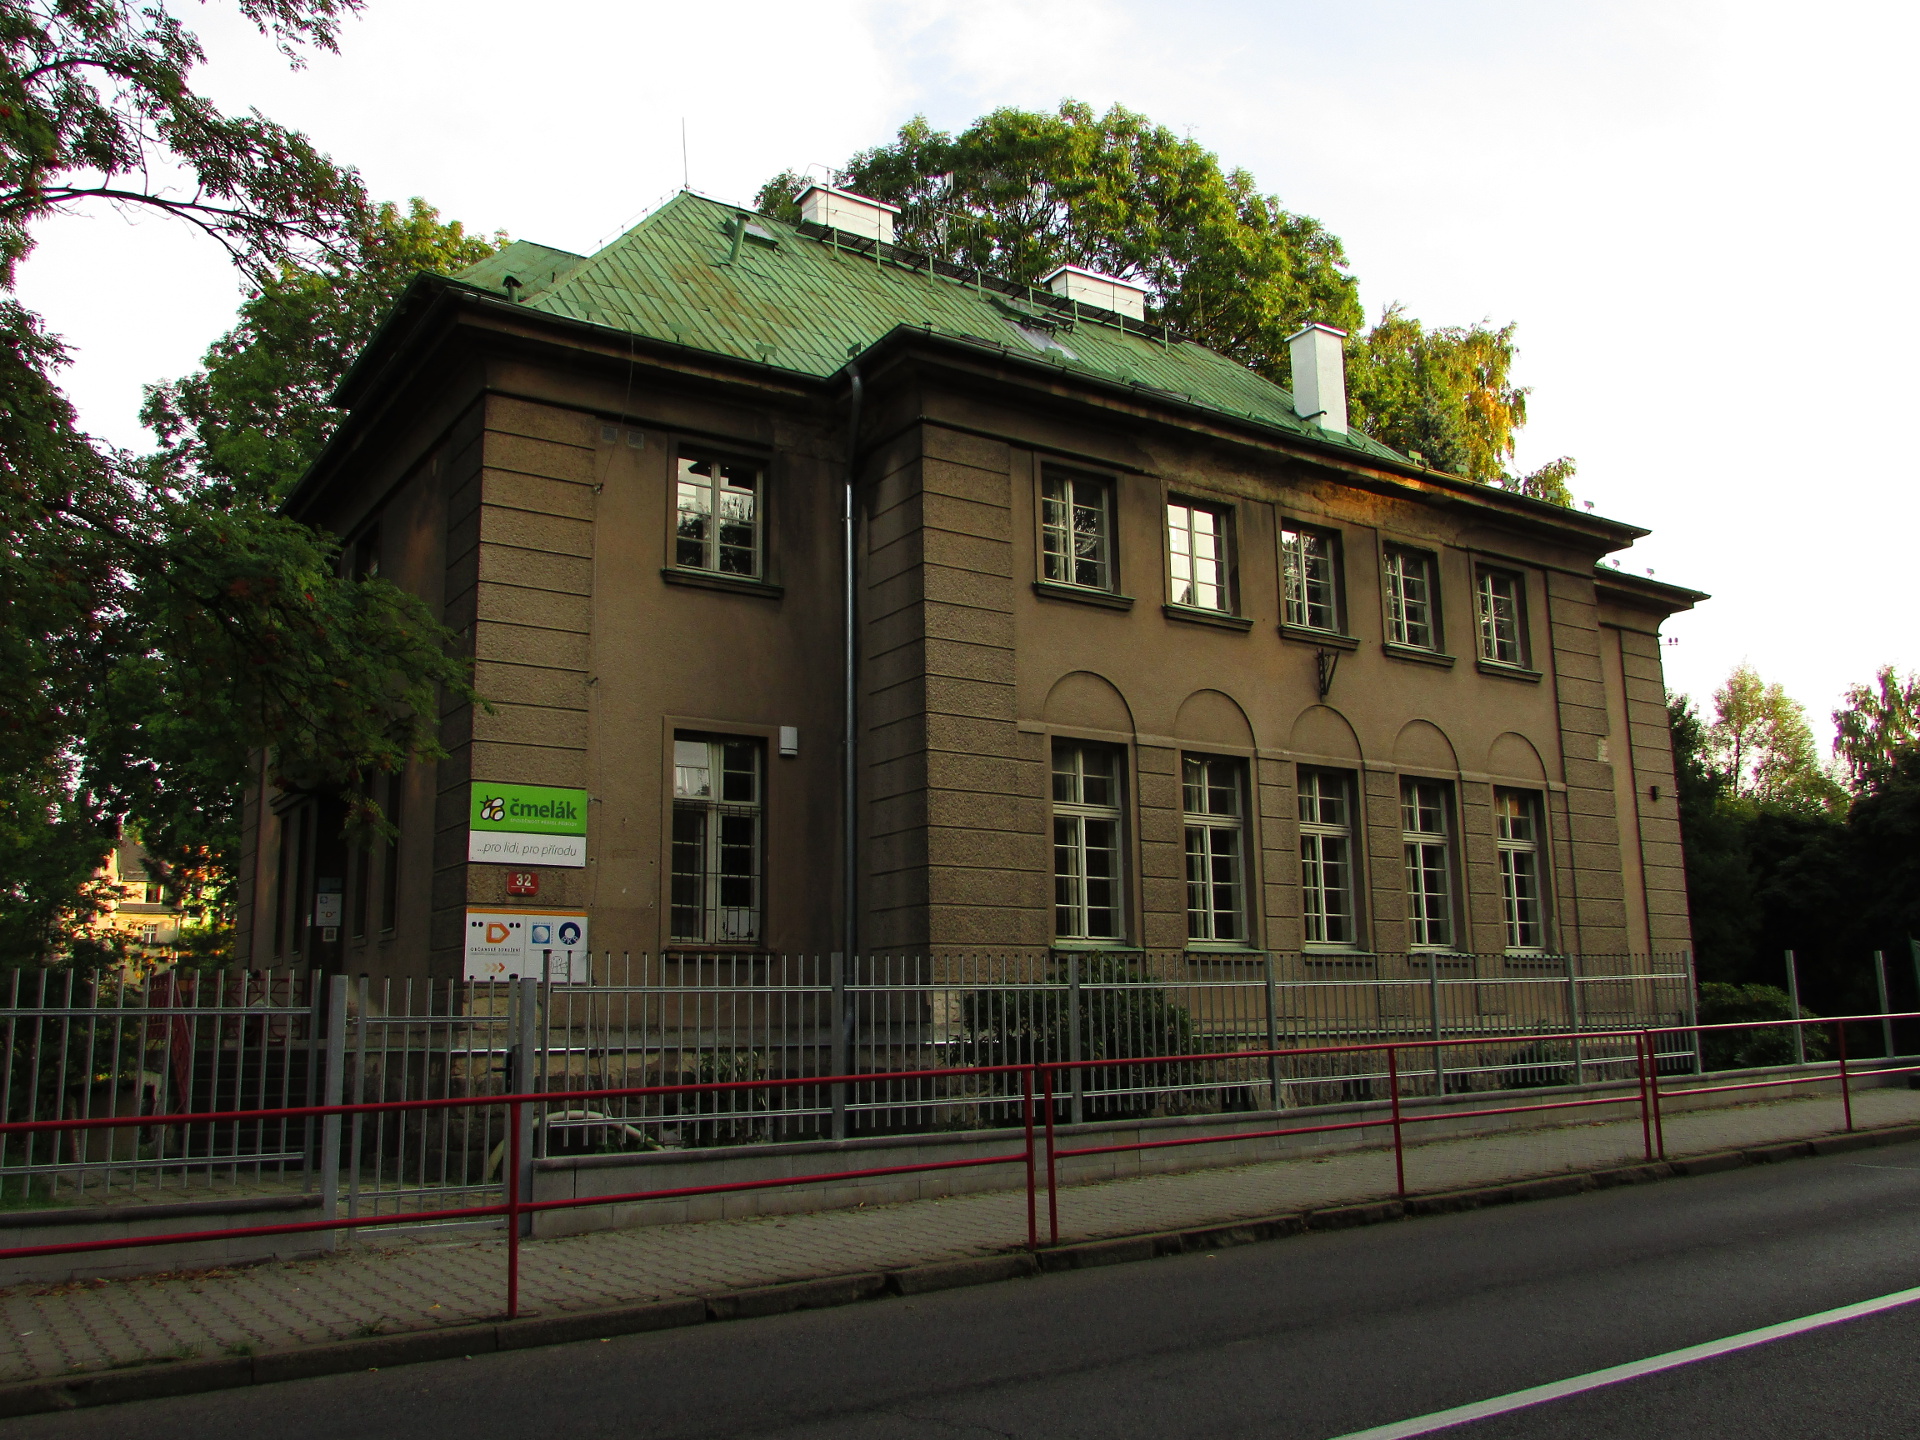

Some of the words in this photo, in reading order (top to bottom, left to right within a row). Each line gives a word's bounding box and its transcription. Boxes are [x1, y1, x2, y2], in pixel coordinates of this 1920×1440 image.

[510, 798, 577, 820] čmelák
[522, 845, 540, 857] pro
[540, 844, 577, 858] přírodu
[516, 873, 532, 887] 32
